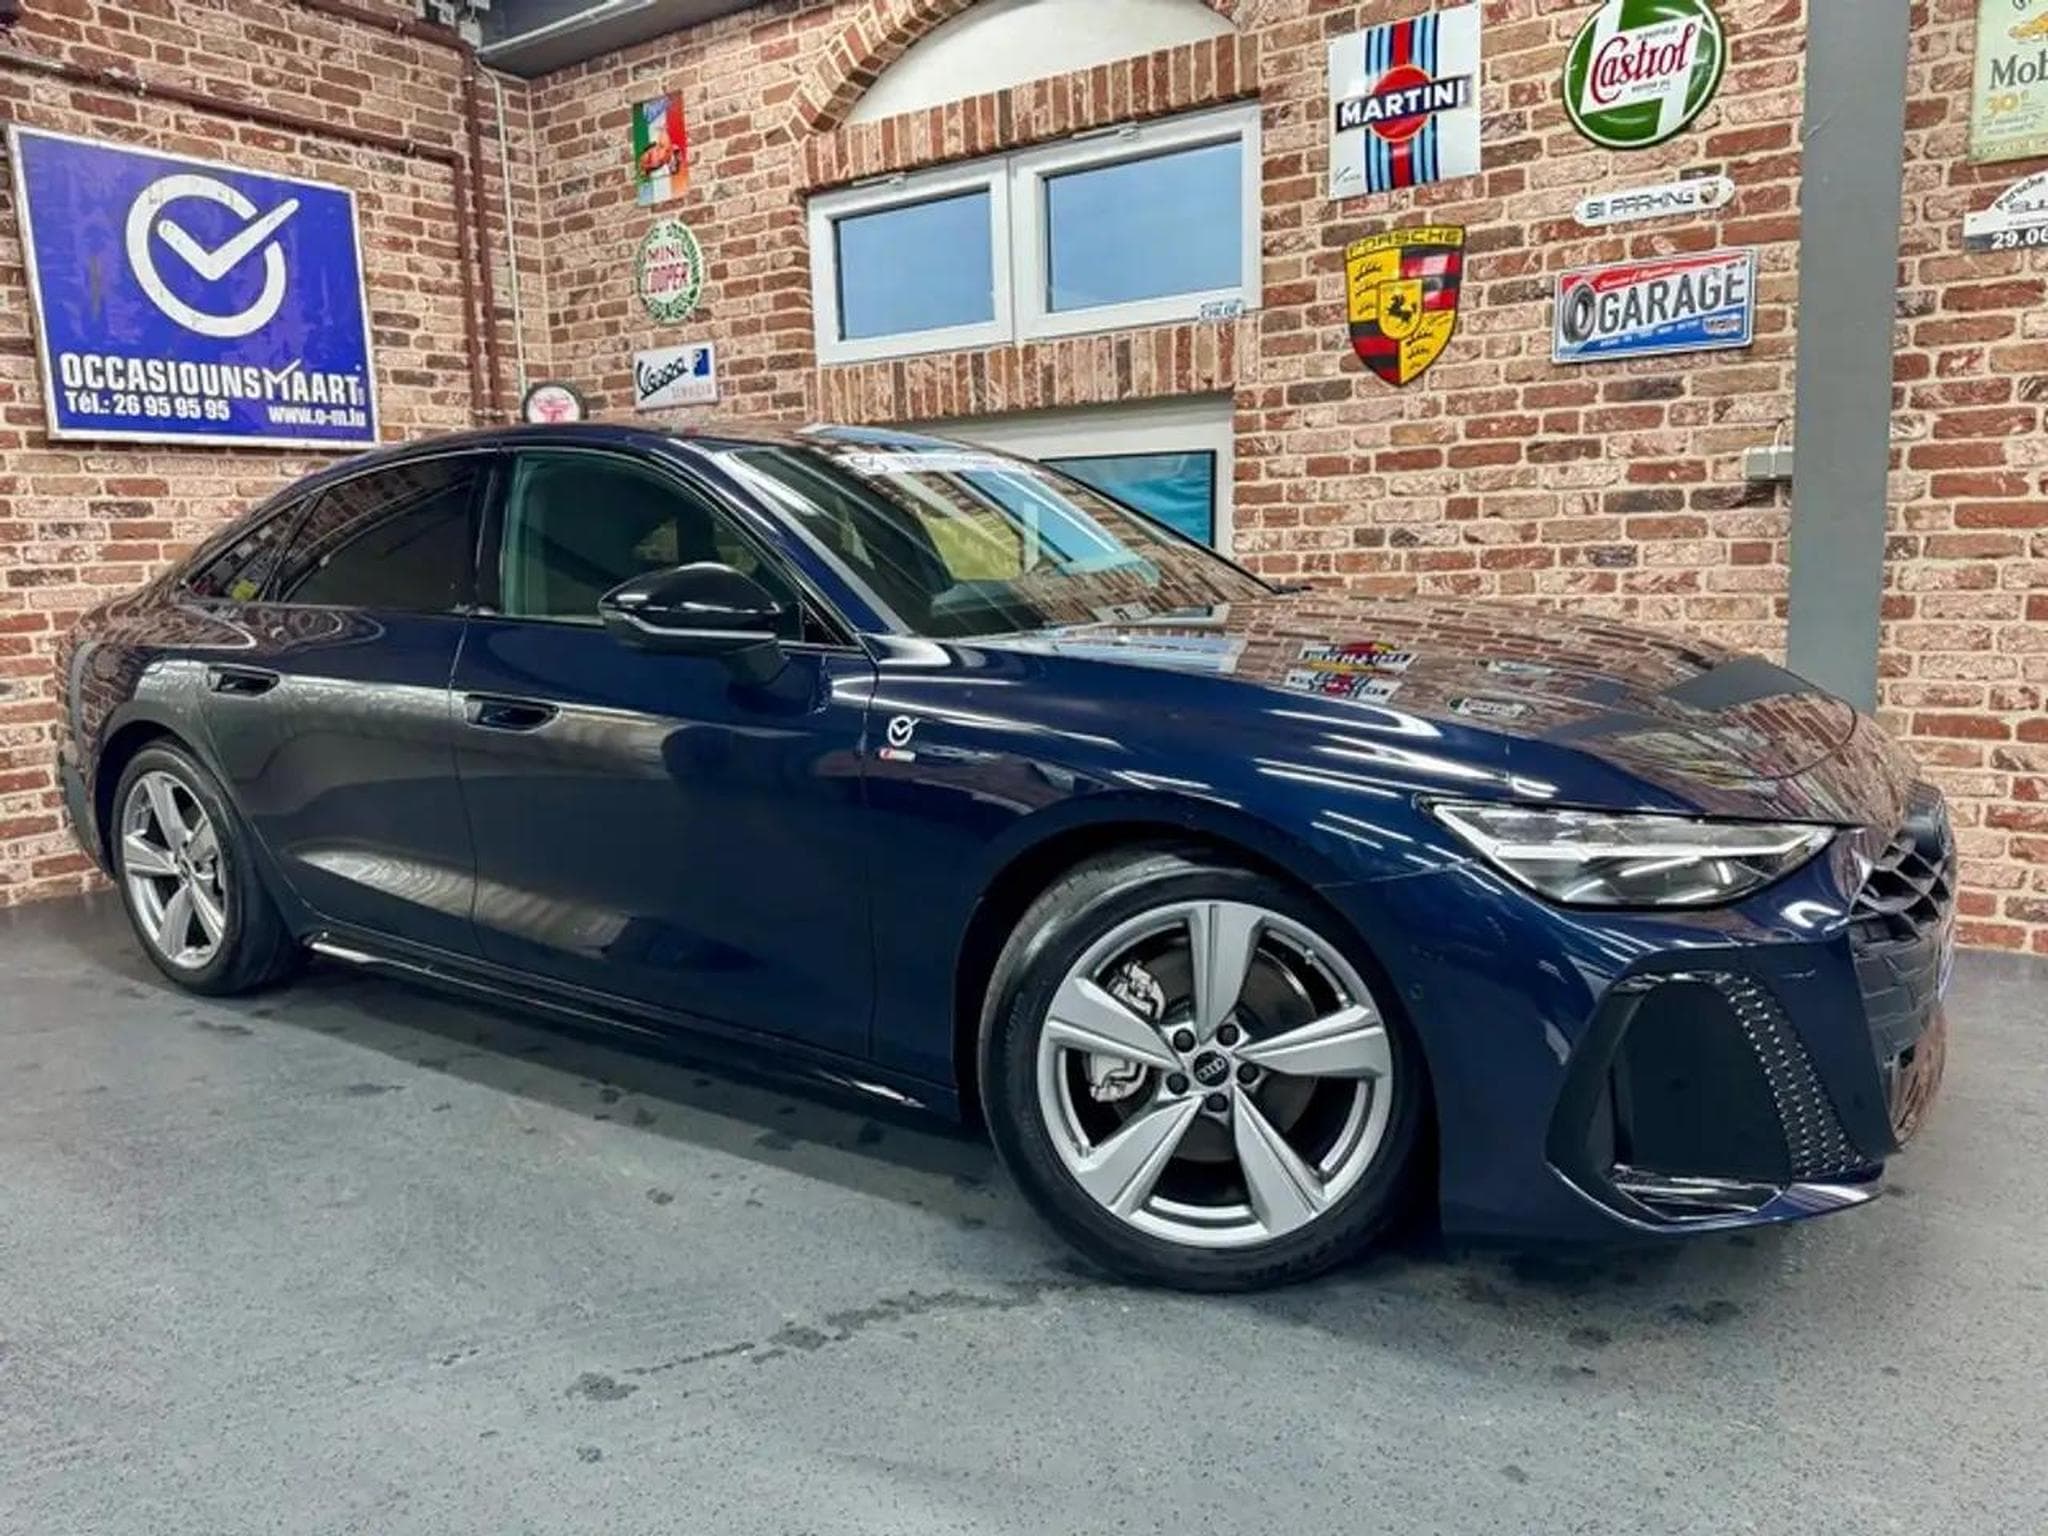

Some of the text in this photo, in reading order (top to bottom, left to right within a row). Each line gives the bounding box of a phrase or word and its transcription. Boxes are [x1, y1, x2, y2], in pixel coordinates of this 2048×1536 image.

[1591, 22, 1697, 104] Castrol
[1340, 78, 1465, 128] MARTINI
[1610, 189, 1695, 216] PARKING
[645, 241, 683, 263] MINI
[1346, 229, 1463, 259] PORSCHE
[645, 261, 688, 295] COOPER
[1598, 259, 1748, 334] GARAGE
[636, 357, 689, 401] Vespa
[112, 393, 141, 416] 26
[144, 396, 171, 418] 95
[174, 397, 201, 420] 95
[204, 399, 230, 421] 95
[268, 406, 366, 428] www.o-m.lu
